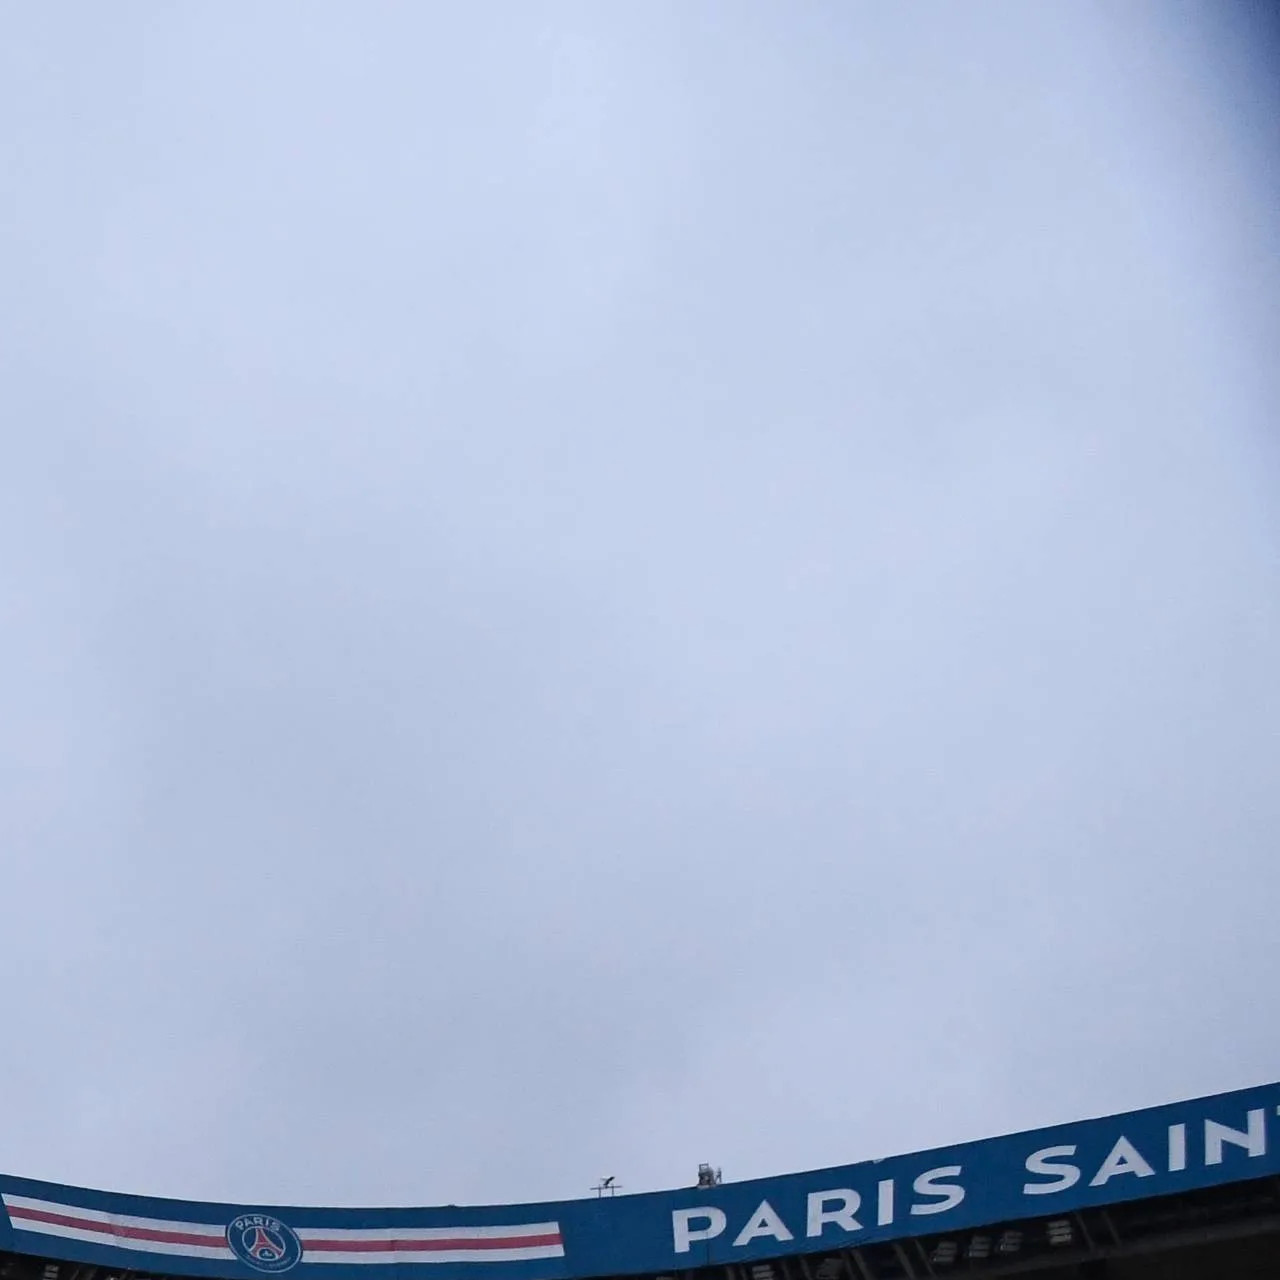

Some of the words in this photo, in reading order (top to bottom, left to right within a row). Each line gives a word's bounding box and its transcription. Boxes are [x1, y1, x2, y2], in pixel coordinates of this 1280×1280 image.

[672, 1165, 965, 1253] PARIS
[1024, 1104, 1280, 1196] SAIN
[235, 1216, 281, 1232] PARIS
